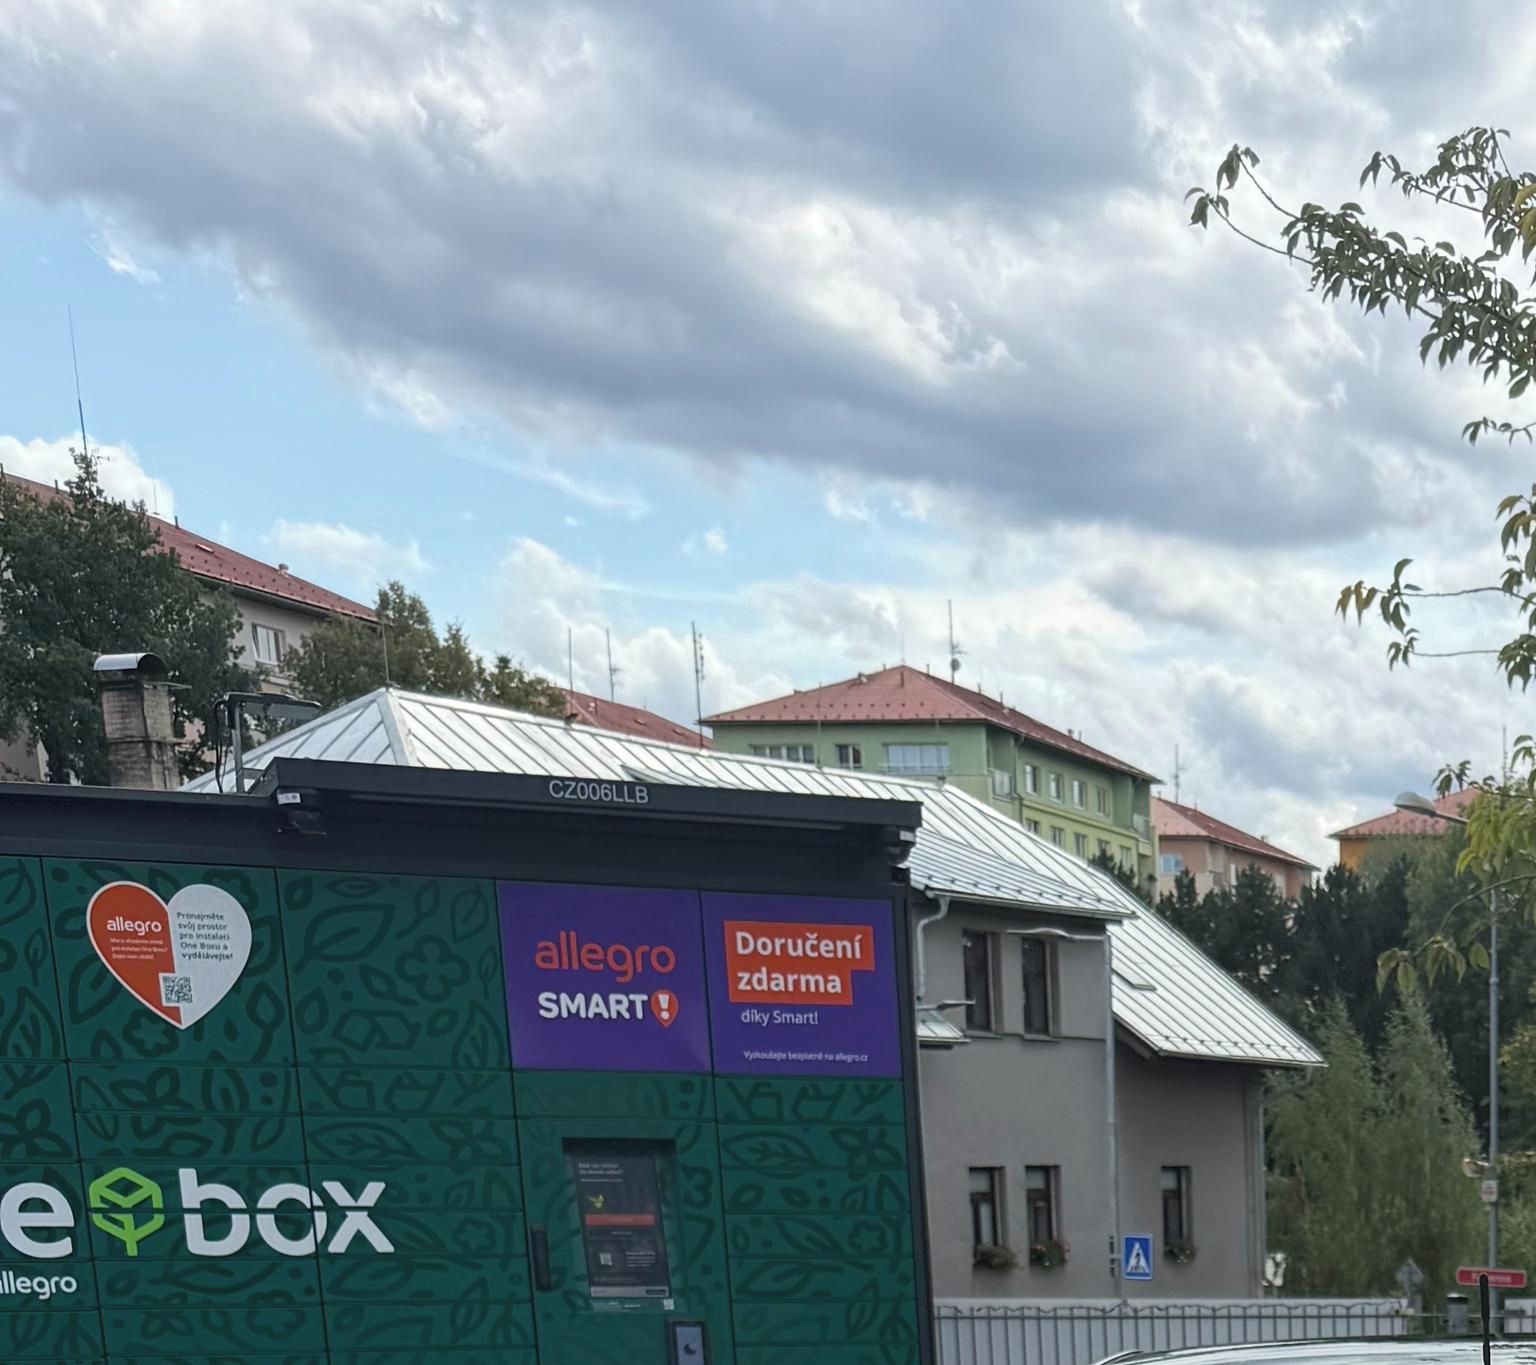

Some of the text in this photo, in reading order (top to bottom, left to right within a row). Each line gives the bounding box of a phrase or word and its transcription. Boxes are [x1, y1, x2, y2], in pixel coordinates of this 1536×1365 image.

[549, 780, 649, 804] CZ006LLB
[107, 916, 162, 936] allegro
[176, 911, 225, 922] Pronajměte
[534, 930, 676, 983] allegro
[735, 931, 862, 960] Doručení
[737, 967, 842, 994] zdarma
[741, 1009, 819, 1026] díky Smart!
[178, 1168, 395, 1257] box
[0, 1270, 78, 1300] llegro
